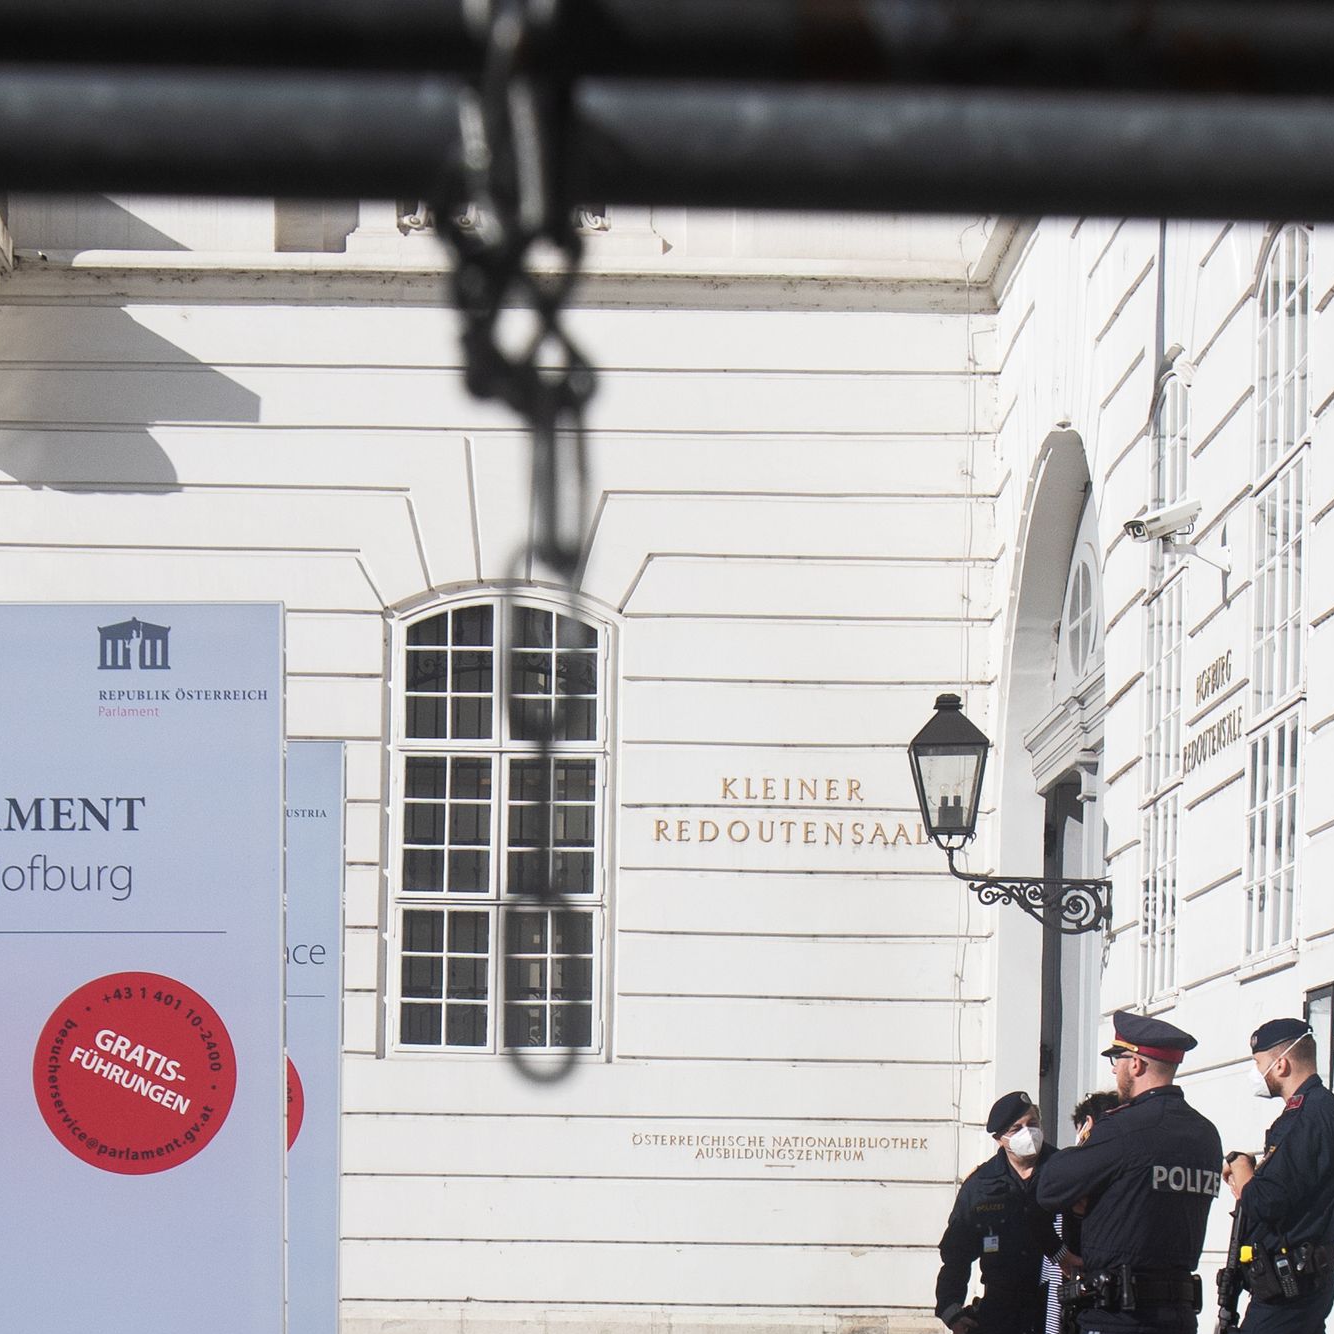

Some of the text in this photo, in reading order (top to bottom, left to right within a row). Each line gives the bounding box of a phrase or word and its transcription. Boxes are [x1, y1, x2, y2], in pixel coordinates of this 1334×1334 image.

[1196, 649, 1232, 707] HOFBURG
[98, 687, 268, 701] REPUBLIK ÖSTERREICH
[98, 706, 159, 718] Parlament
[1182, 706, 1243, 778] REDOUTENSÄLE
[721, 777, 865, 801] KLEINER
[285, 809, 327, 818] USTRIA
[652, 819, 930, 846] REDOUTENSAAL
[102, 987, 222, 1072] +43 1 401 10-2400
[94, 1029, 186, 1082] GRATIS-
[48, 1018, 214, 1160] besucherservice@parlament.gv.at
[69, 1046, 191, 1115] FÜHRUNGEN
[632, 1132, 929, 1150] ÖSTERREICHISCHE NATIONALBIBLIOTHEK
[695, 1148, 865, 1163] AUSBILDUNGSZENTRUM
[1152, 1165, 1220, 1198] POLIZE
